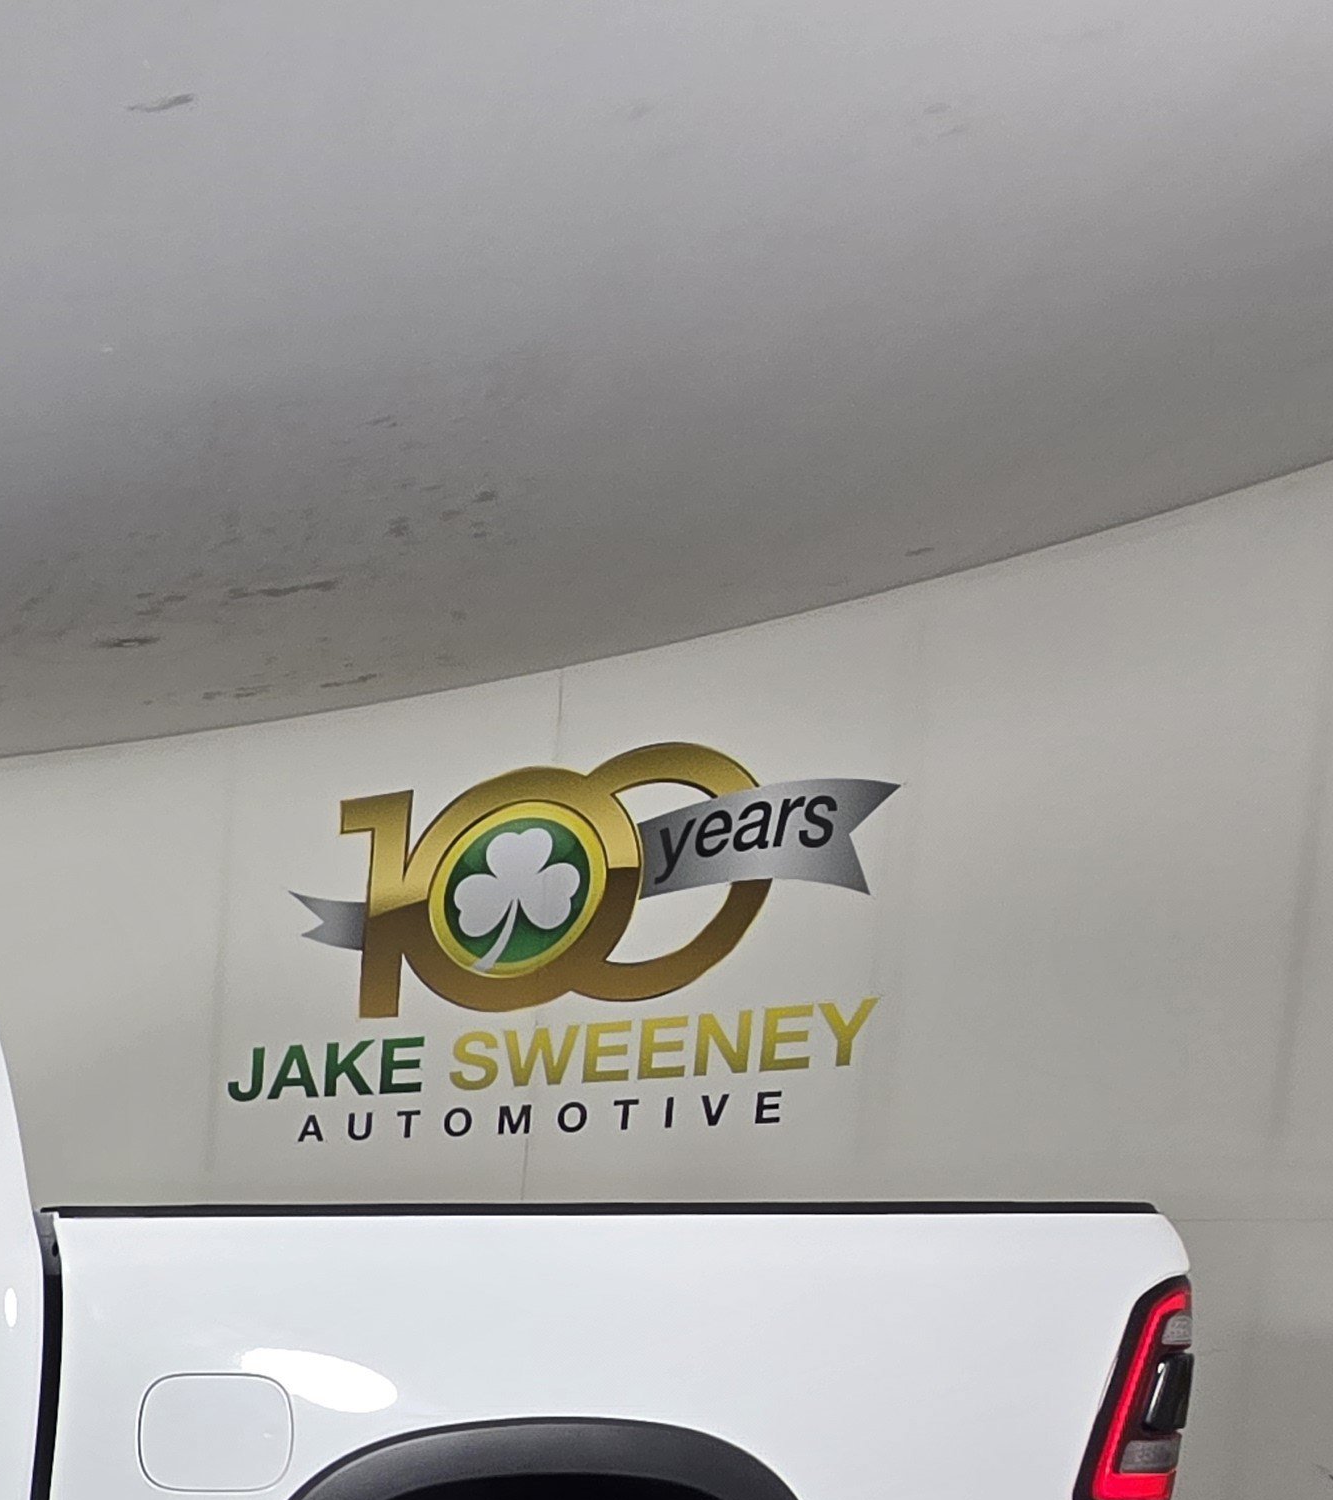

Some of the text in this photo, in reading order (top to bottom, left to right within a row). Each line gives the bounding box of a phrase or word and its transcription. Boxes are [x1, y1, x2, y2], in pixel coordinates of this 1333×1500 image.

[654, 793, 838, 885] years
[228, 997, 879, 1103] JAKE SWEENEY
[297, 1091, 783, 1143] AUTOMOTIVE
